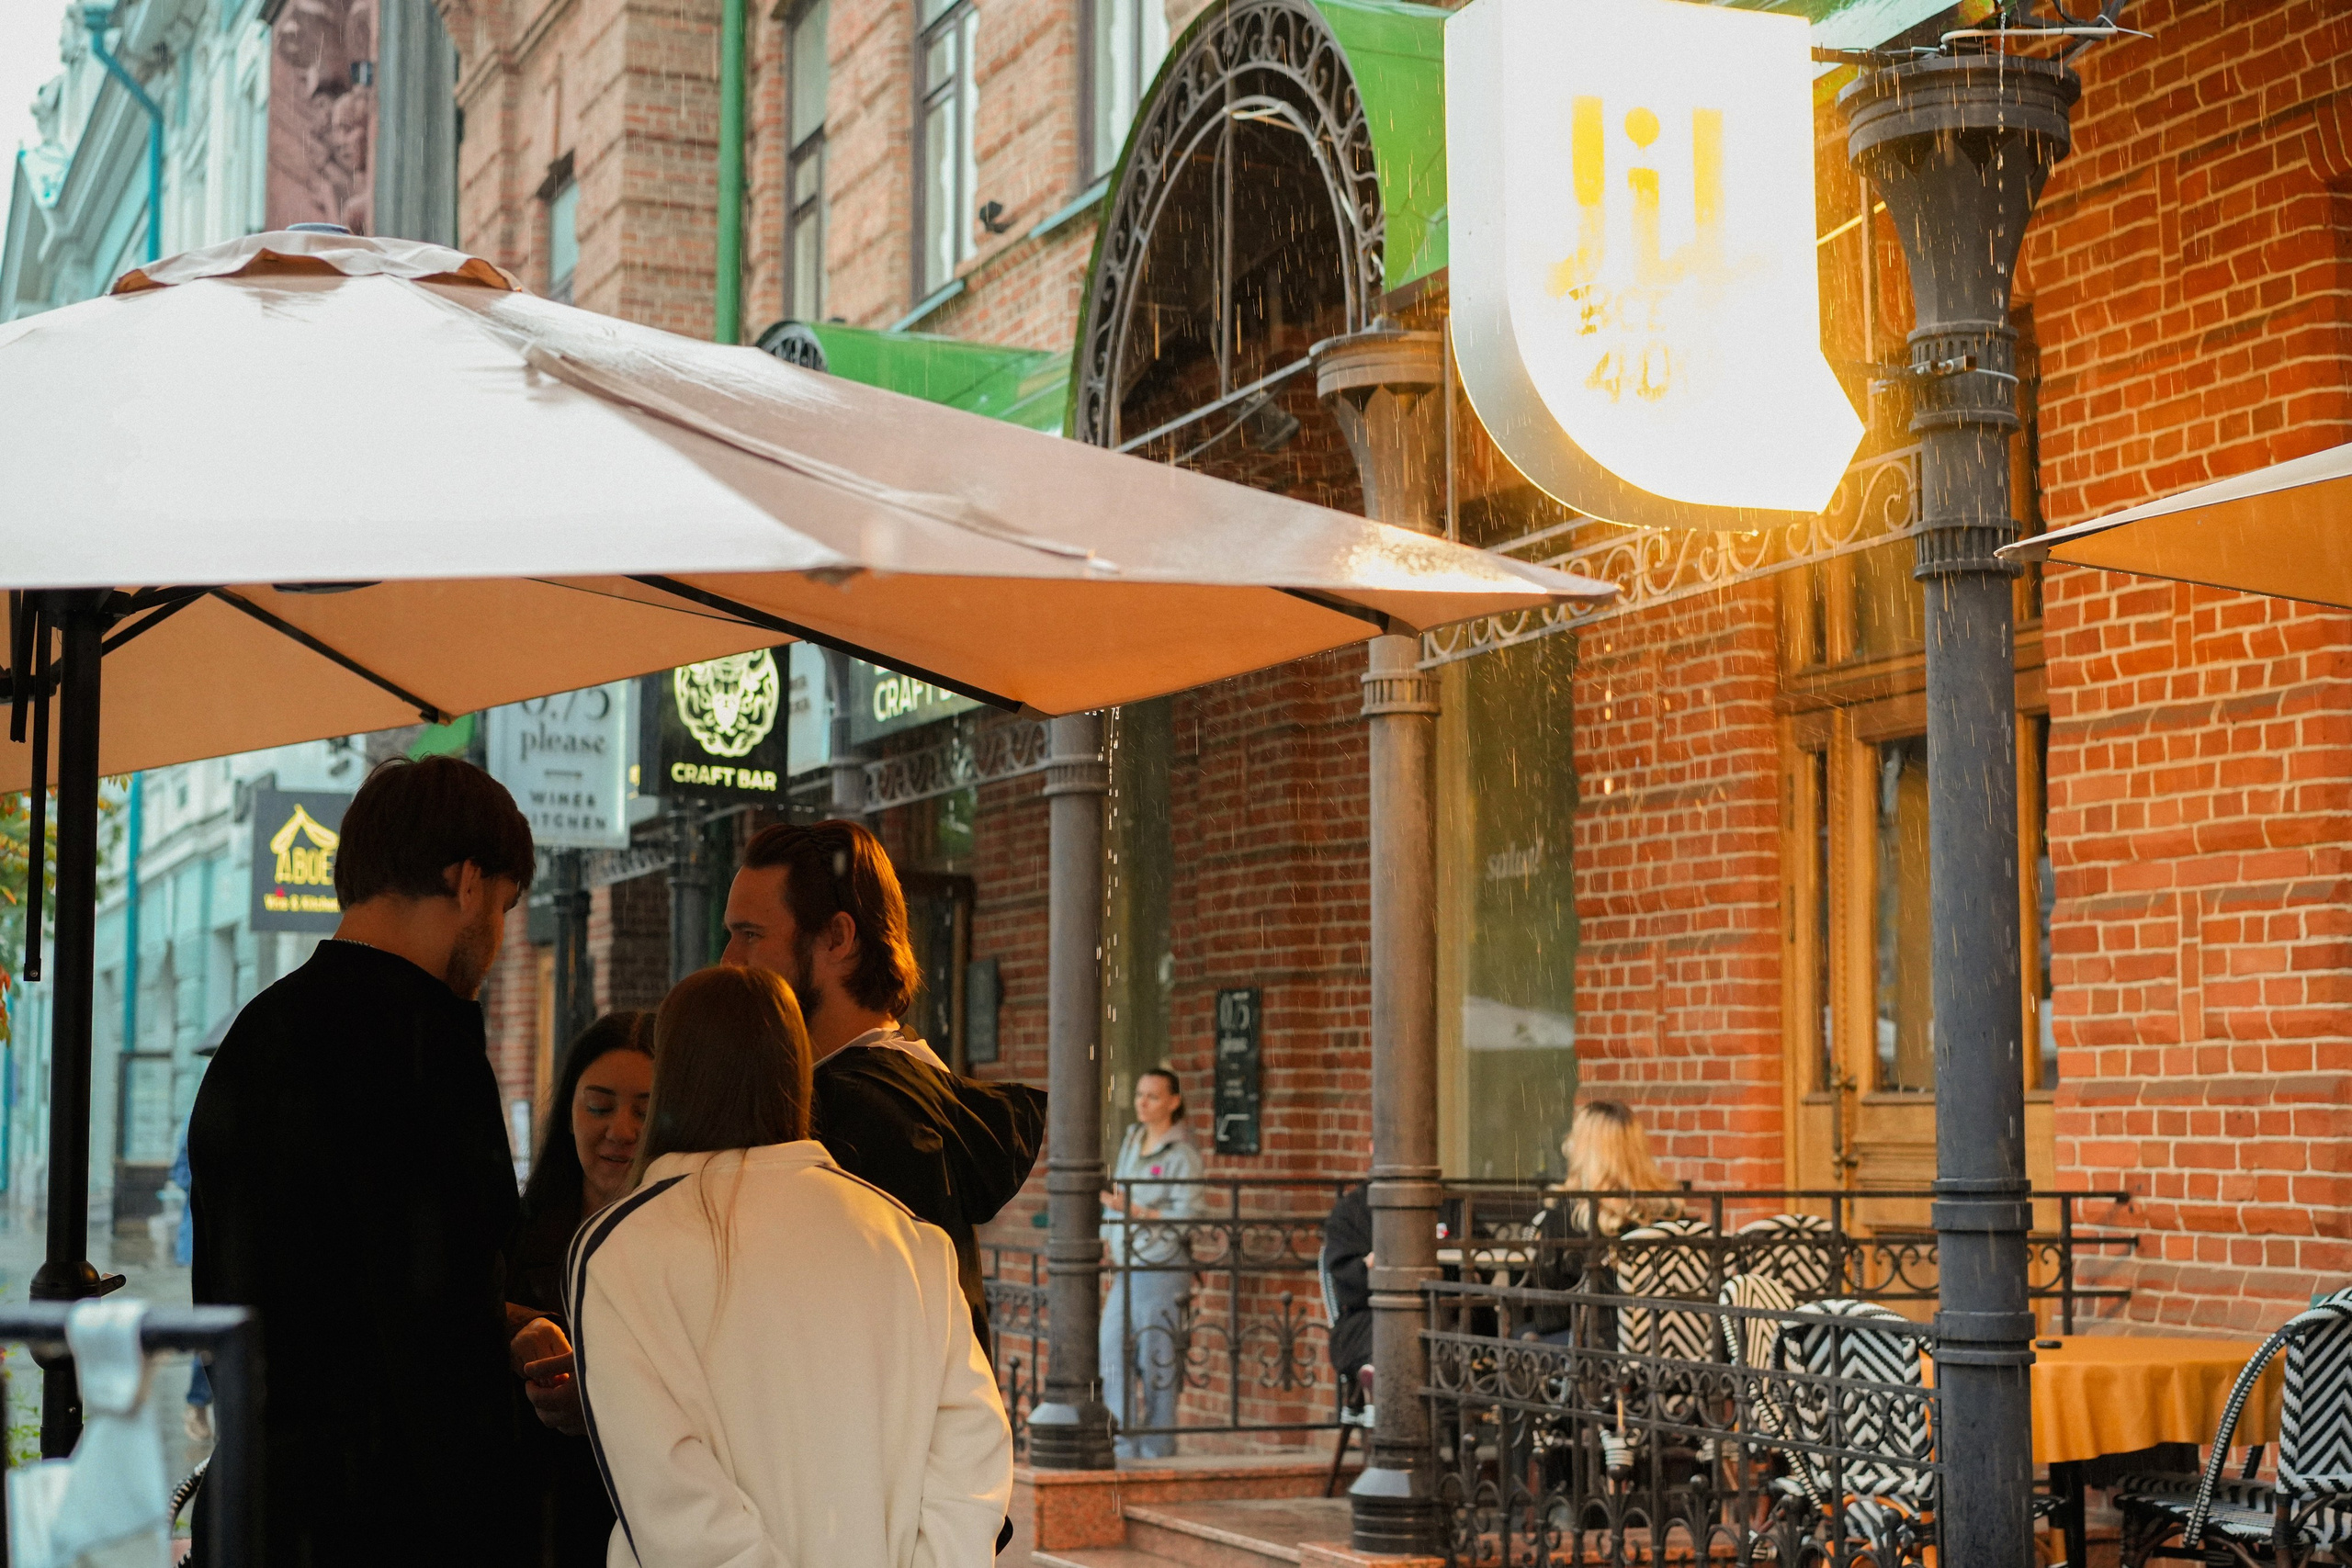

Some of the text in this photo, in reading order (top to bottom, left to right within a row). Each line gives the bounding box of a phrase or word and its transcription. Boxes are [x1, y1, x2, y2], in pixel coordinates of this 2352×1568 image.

[521, 721, 605, 761] please
[671, 761, 777, 791] CRAFT BAR
[531, 811, 605, 829] ITCHEN
